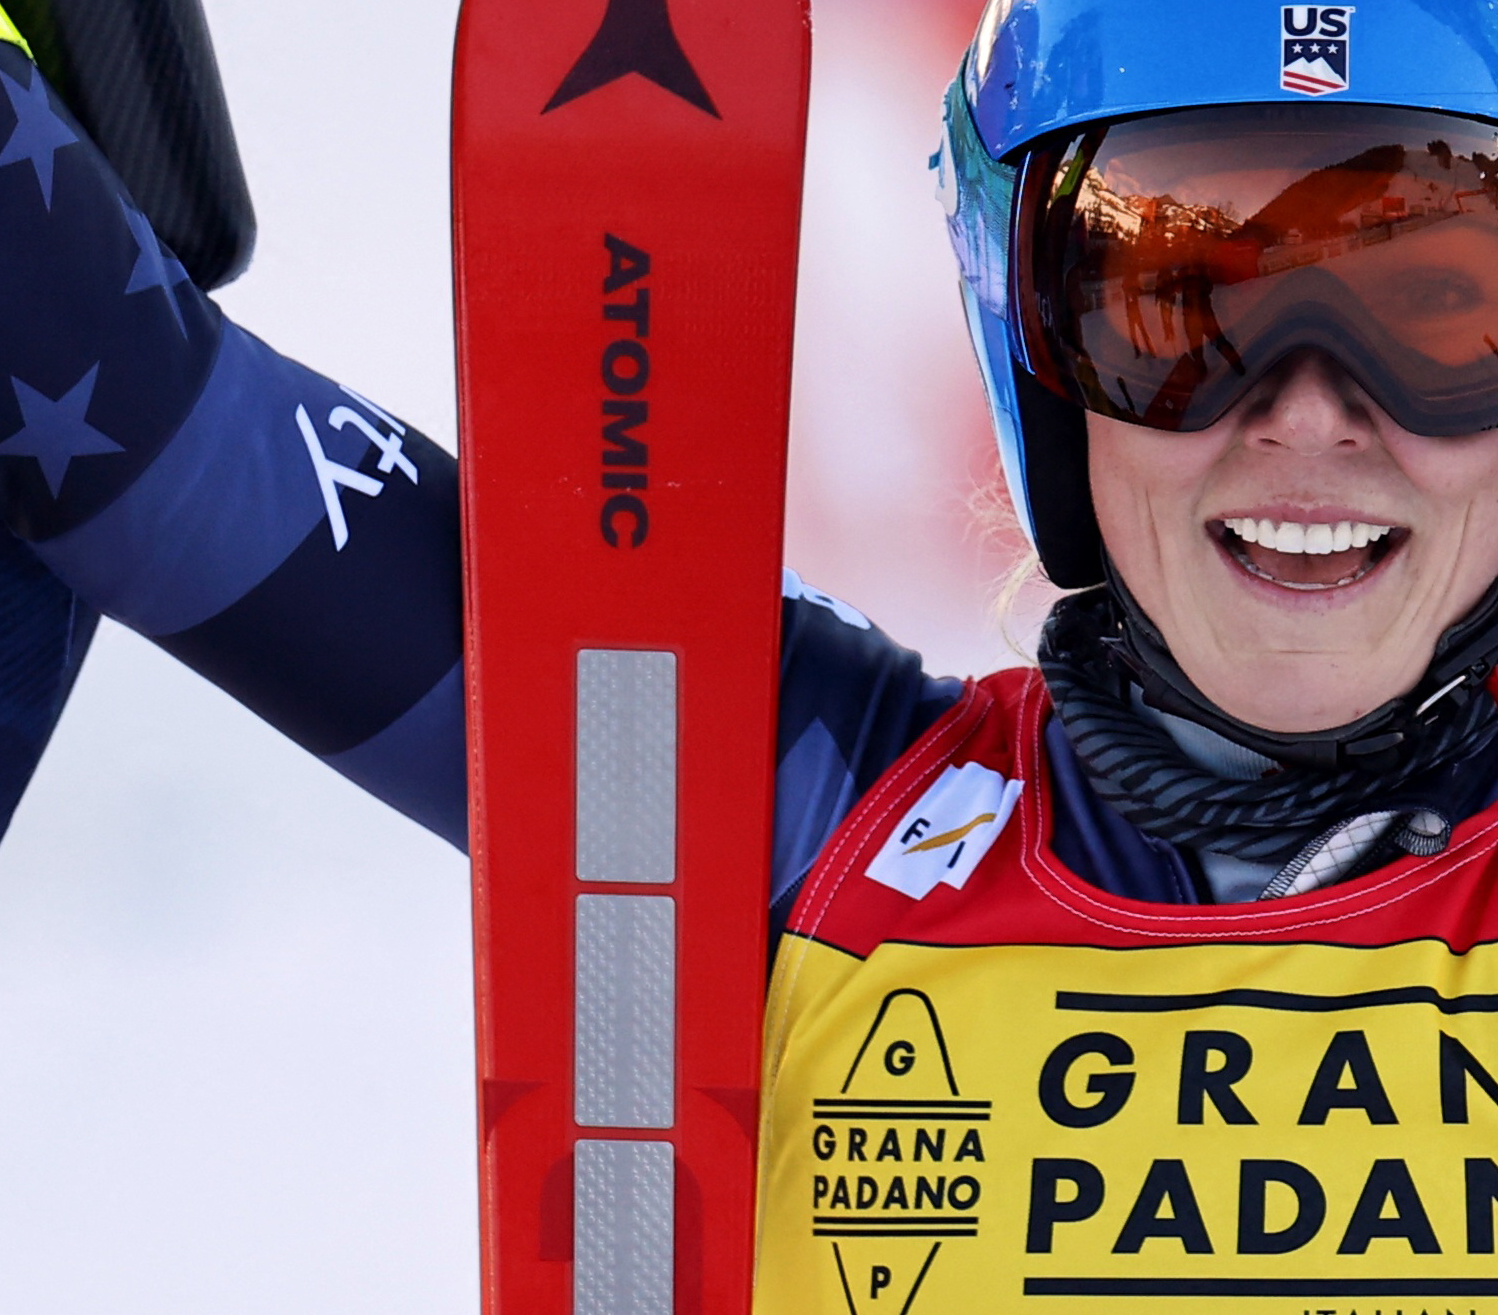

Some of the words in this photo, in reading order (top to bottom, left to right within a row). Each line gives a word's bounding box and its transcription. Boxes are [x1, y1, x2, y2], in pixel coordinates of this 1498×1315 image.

[1283, 8, 1348, 37] US
[599, 233, 652, 549] ATOMIC
[882, 1039, 917, 1078] G
[812, 1123, 986, 1163] GRANA
[812, 1174, 982, 1212] PADANO
[869, 1265, 892, 1300] P
